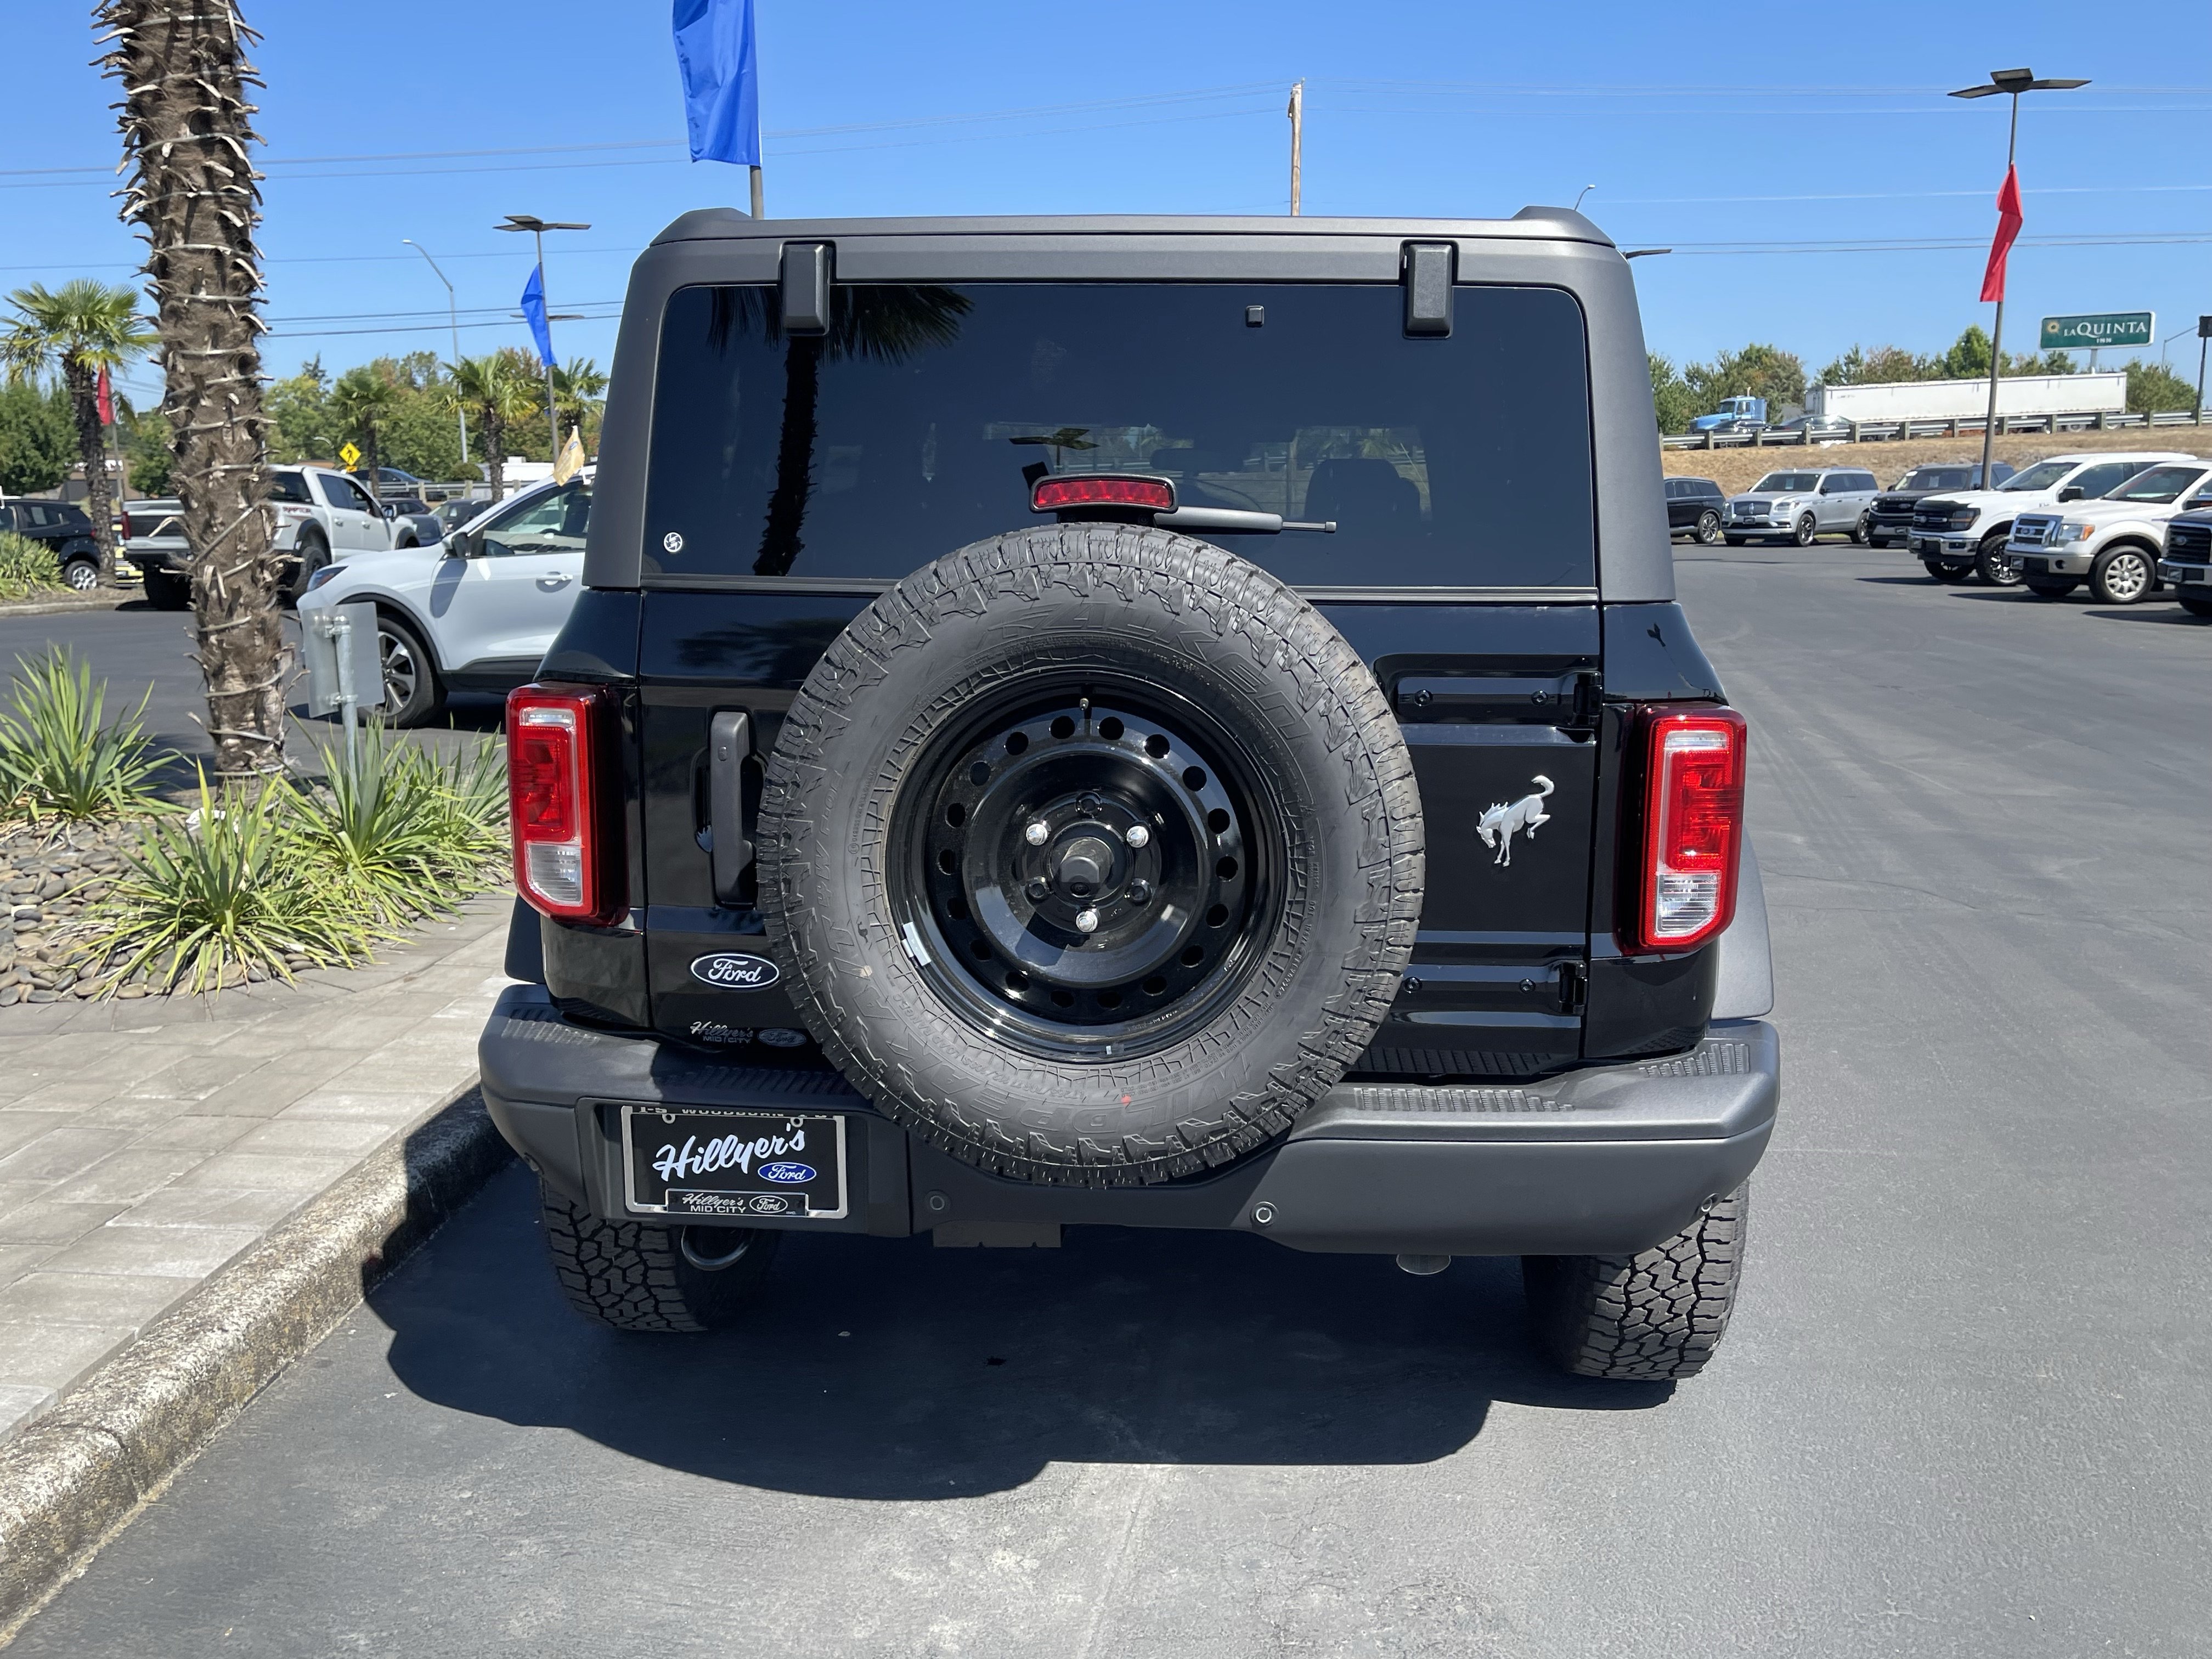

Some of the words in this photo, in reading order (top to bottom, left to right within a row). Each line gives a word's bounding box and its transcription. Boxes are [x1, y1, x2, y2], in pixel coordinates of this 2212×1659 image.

[2076, 321, 2147, 338] QUINTA
[708, 958, 762, 982] Ford
[652, 1123, 805, 1181] Hillyer's
[768, 1164, 806, 1180] Ford
[682, 1193, 744, 1207] Hillyer's
[757, 1198, 781, 1211] Ford
[717, 1206, 746, 1214] CITY
